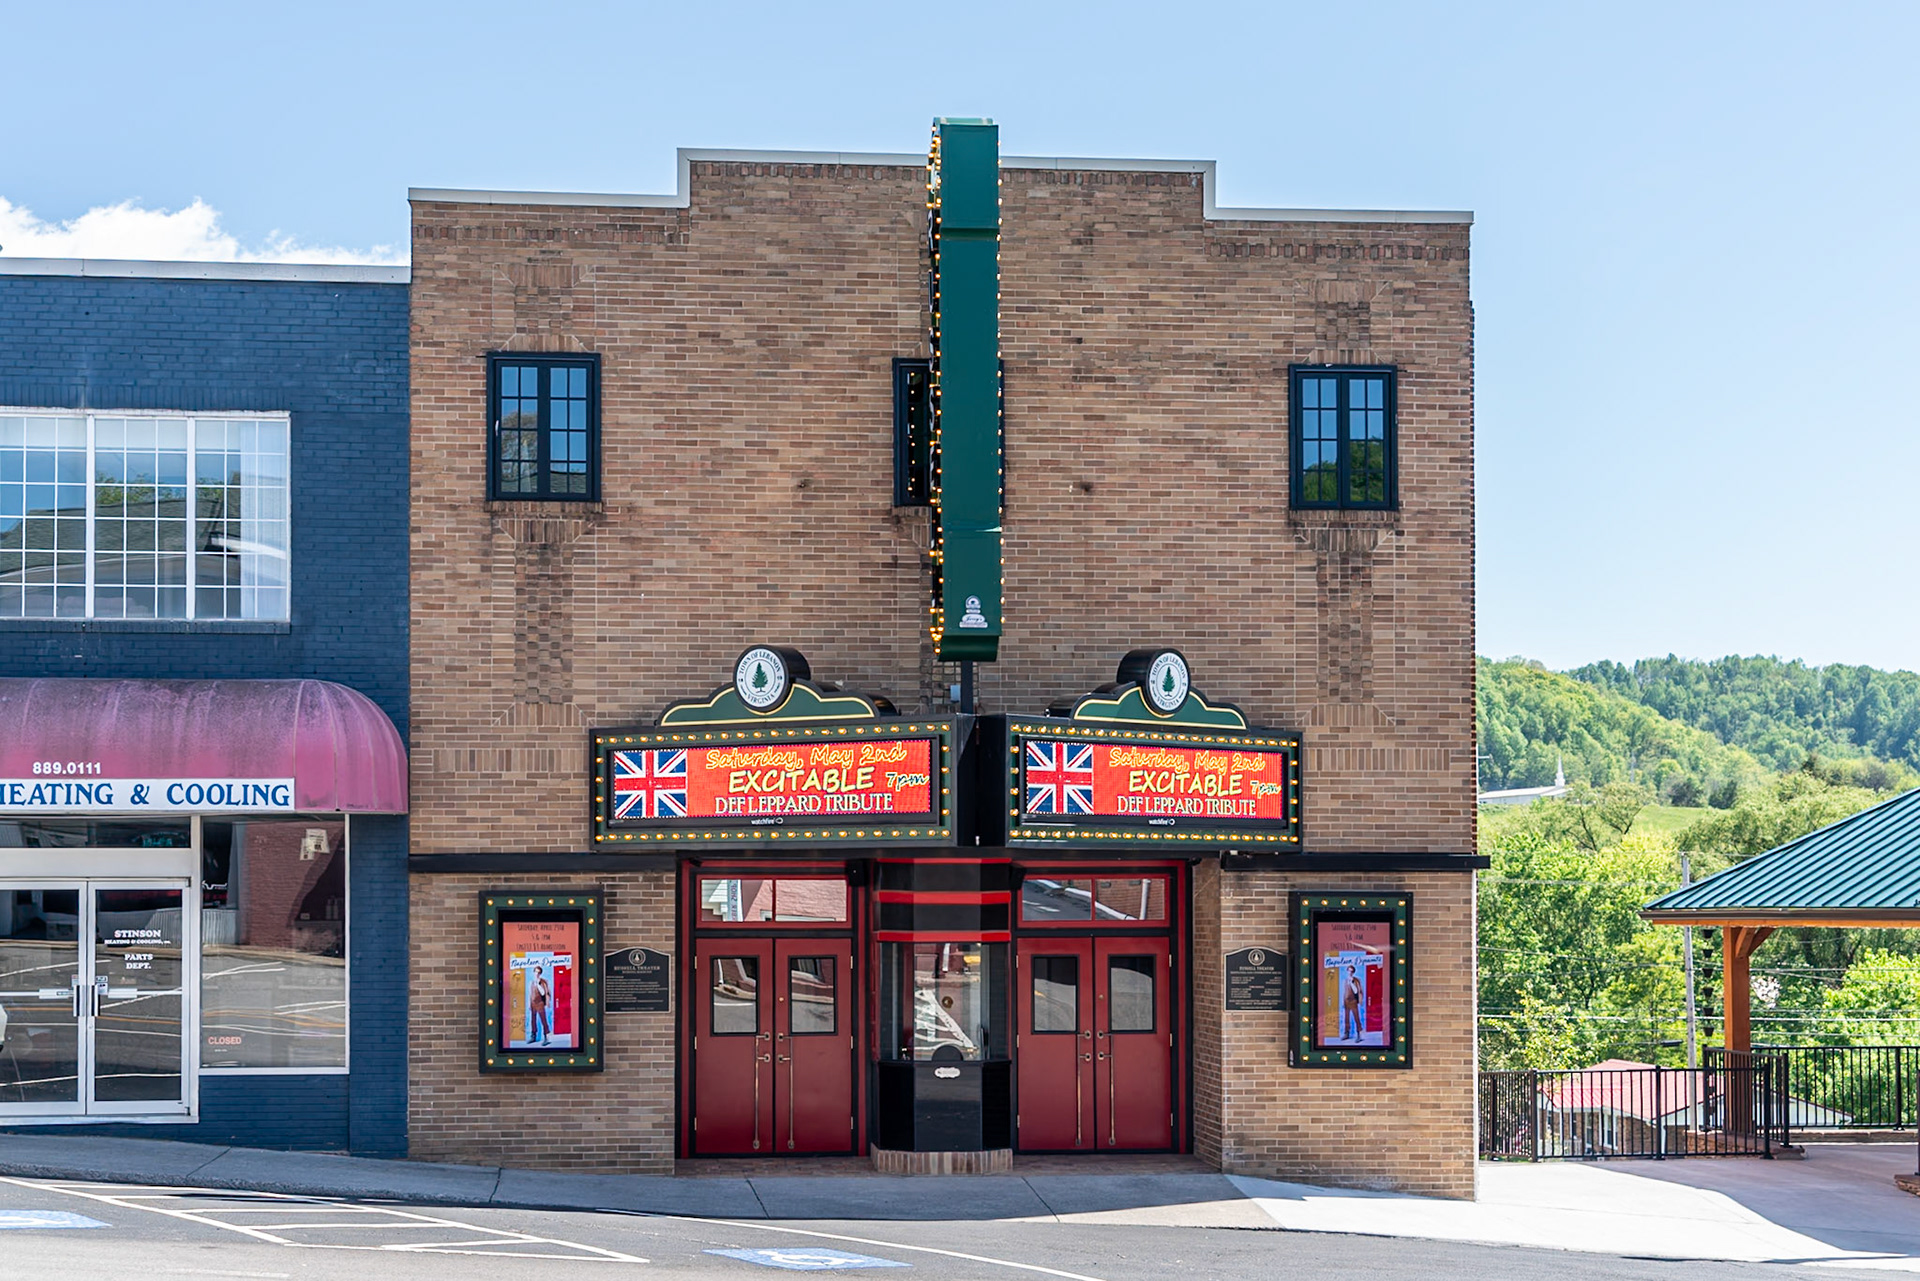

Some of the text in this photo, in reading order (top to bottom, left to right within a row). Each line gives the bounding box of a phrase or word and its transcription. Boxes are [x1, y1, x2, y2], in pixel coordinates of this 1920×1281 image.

[706, 741, 908, 771] Saturday, May 2nd
[1109, 747, 1266, 775] Saturday, May 2nd
[32, 762, 102, 775] 889.0111
[728, 766, 875, 794] EXCITABLE
[885, 772, 930, 791] 7pm
[1129, 770, 1243, 797] EXCITABLE
[1249, 780, 1282, 799] 7pm
[130, 783, 150, 805] &
[166, 783, 290, 807] COOLING
[715, 793, 893, 814] DEF LEPPARD TRIBUTE
[1117, 795, 1257, 816] DEF LEPPARD TRIBUTE
[114, 929, 161, 938] STINSON
[124, 953, 154, 961] PARTS
[208, 1036, 242, 1045] CLOSED
